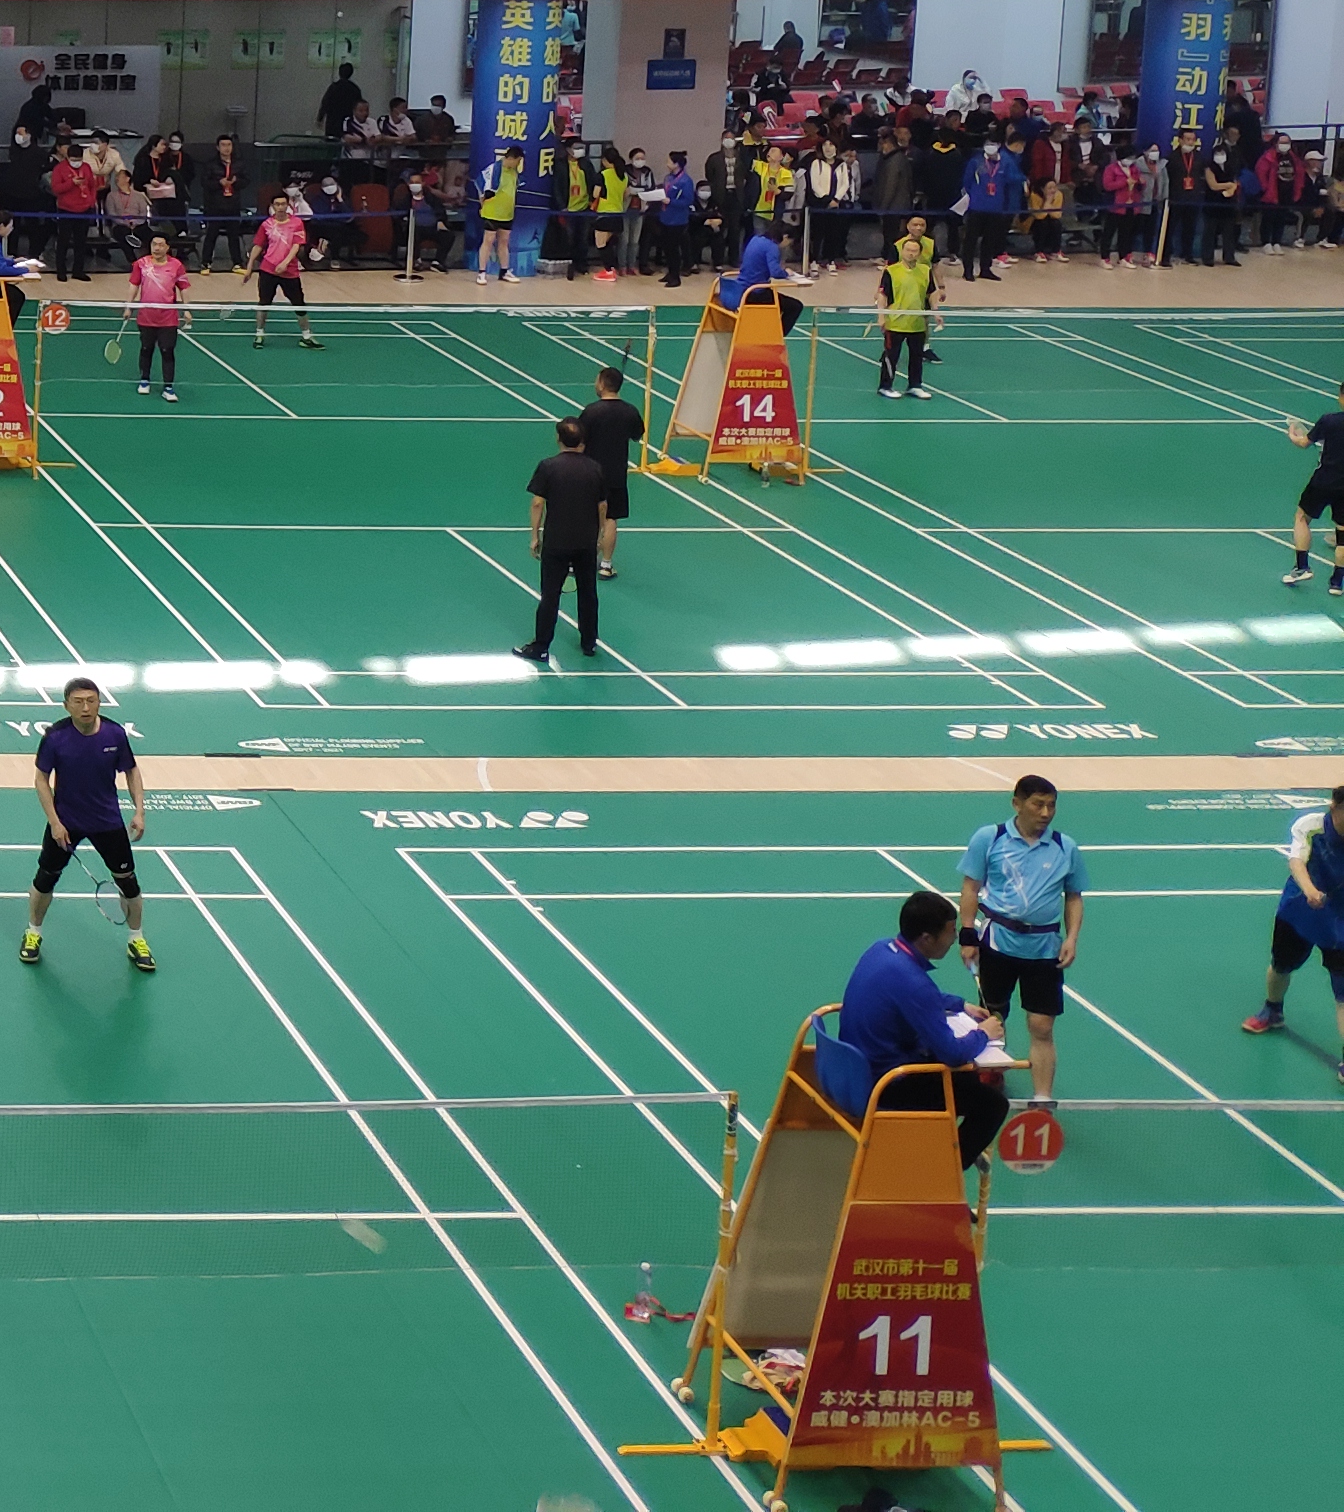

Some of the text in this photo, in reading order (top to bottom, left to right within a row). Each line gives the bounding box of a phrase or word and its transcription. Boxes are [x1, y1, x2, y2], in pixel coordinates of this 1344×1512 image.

[494, 0, 534, 174] 英雄的城
[44, 310, 67, 326] 12
[735, 393, 775, 423] 14
[5, 719, 145, 738] YOX
[1014, 723, 1159, 740] YONEX
[359, 809, 514, 829] YONEX
[1010, 1123, 1050, 1156] 11
[853, 1258, 958, 1277] 武汉市第十一届
[837, 1282, 972, 1301] 机关职工羽毛球比赛
[858, 1315, 934, 1376] 11
[819, 1389, 974, 1408] 本次大赛指定用球
